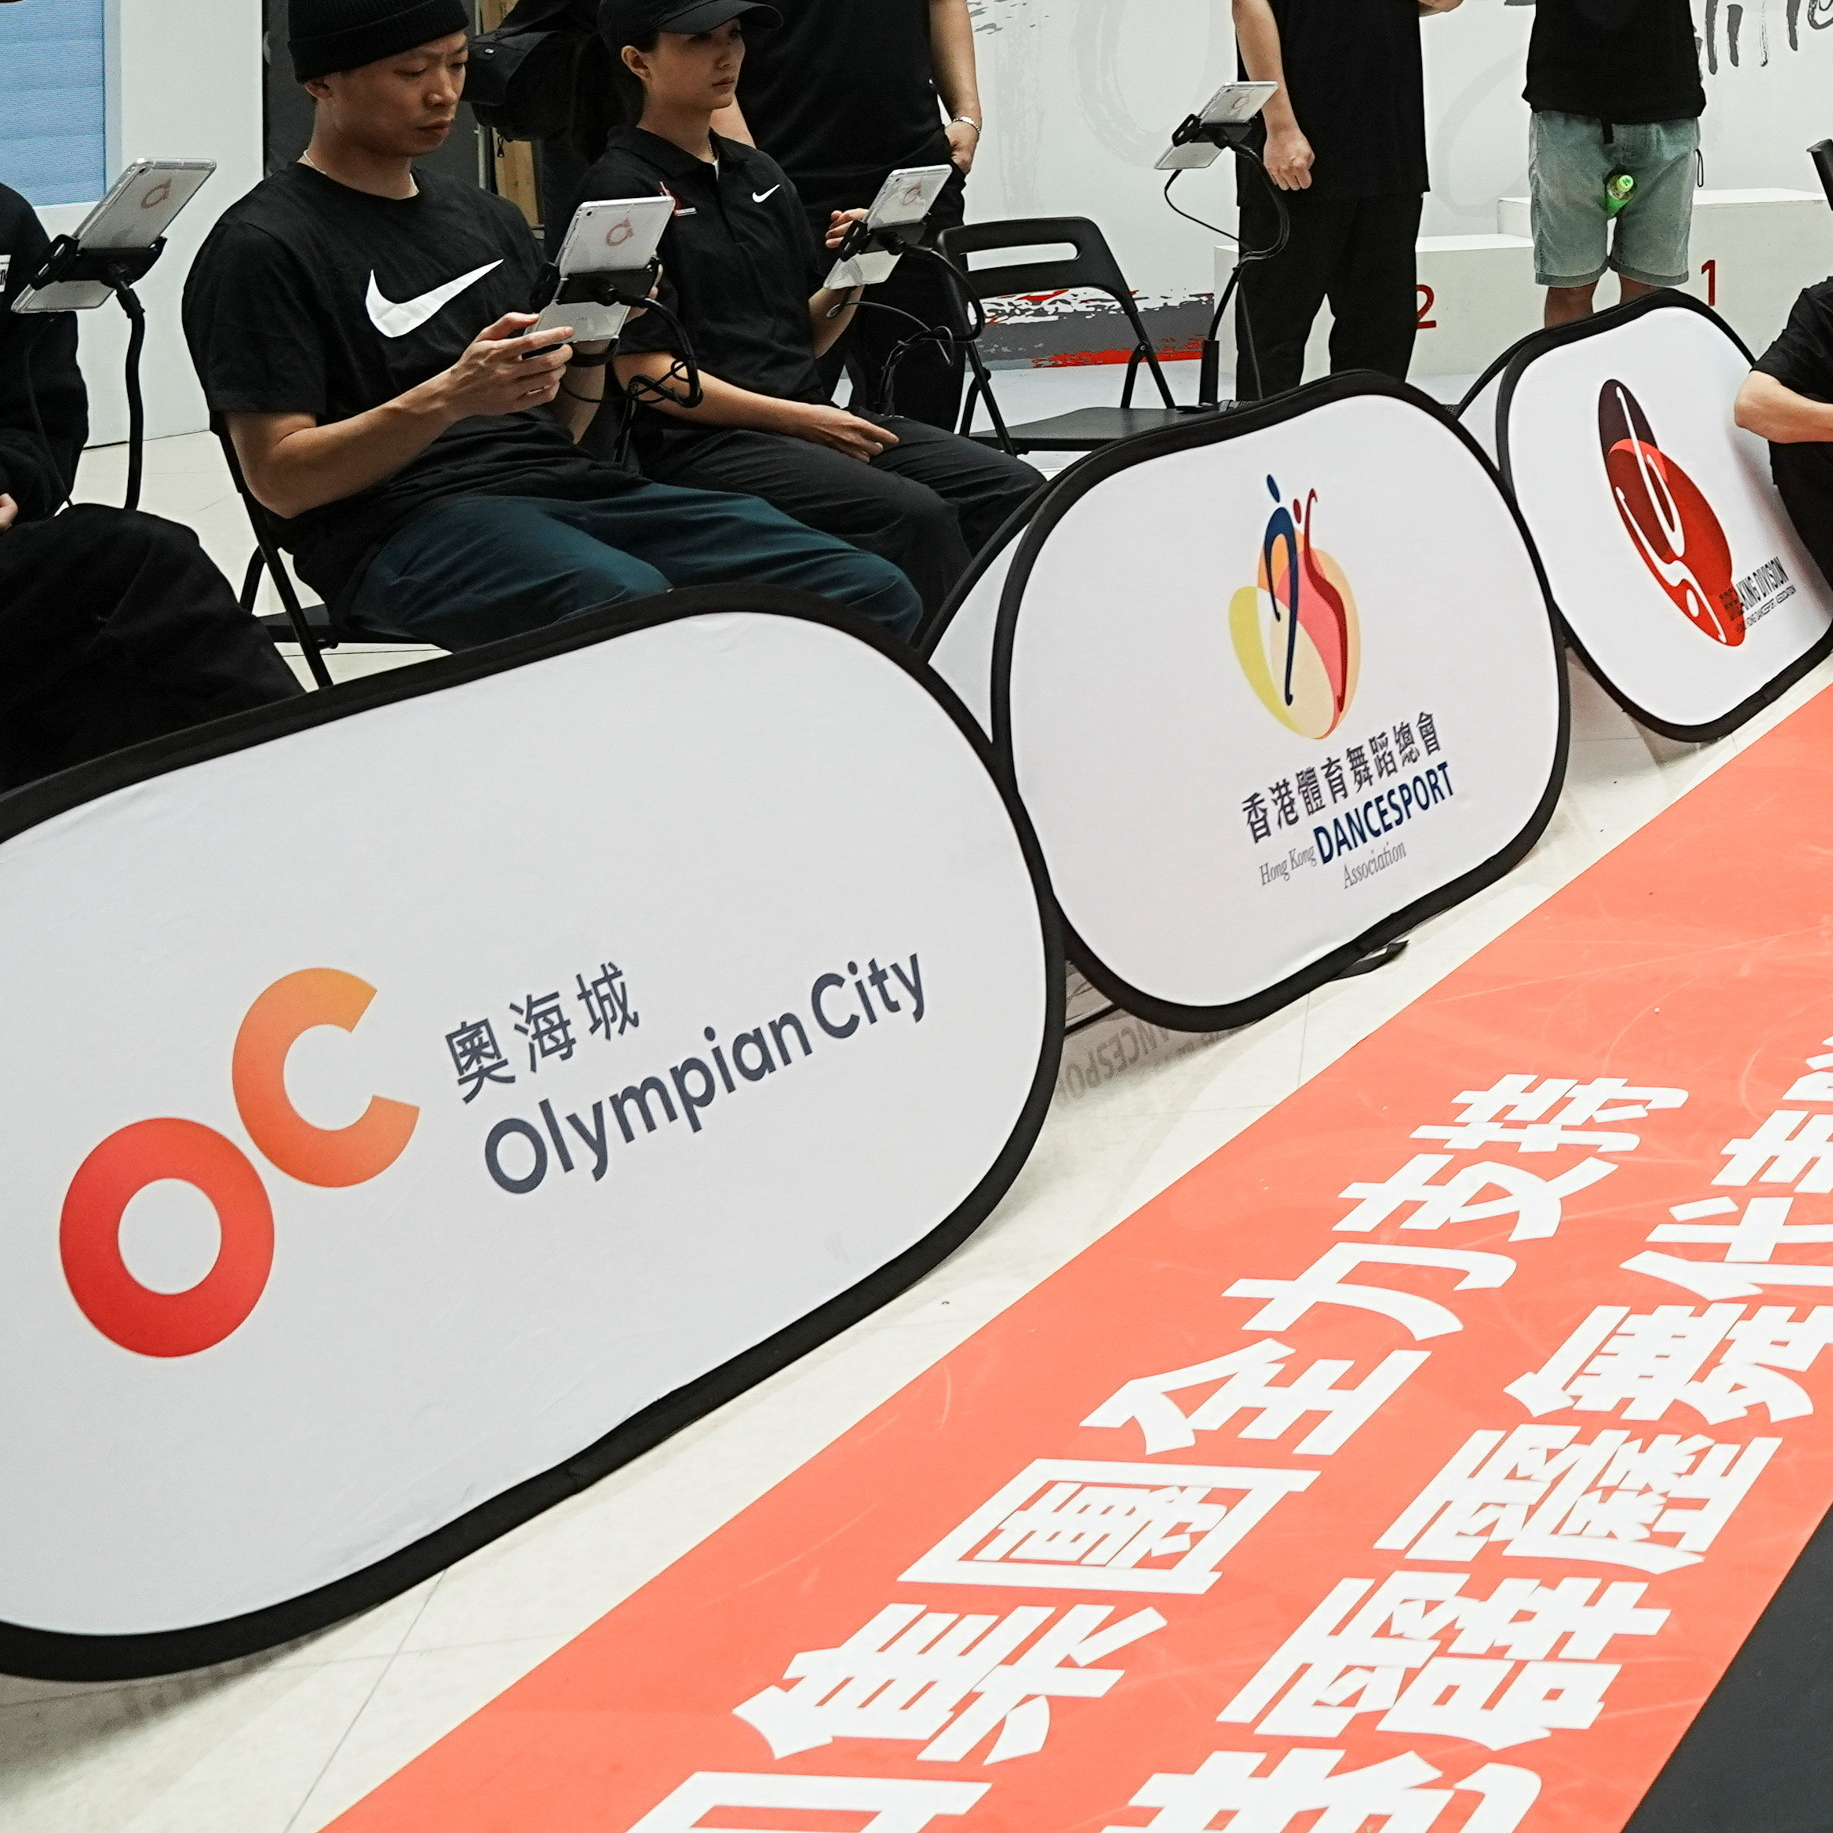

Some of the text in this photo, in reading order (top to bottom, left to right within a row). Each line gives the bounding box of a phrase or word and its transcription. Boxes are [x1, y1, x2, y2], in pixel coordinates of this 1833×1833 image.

[1701, 259, 1716, 306] 1
[1241, 711, 1443, 846] 香港體育舞蹈總會
[1259, 760, 1456, 886] Hong Kong DANCESPORT
[1343, 841, 1408, 889] Association
[444, 960, 641, 1104] 奧海城
[483, 952, 928, 1196] Olympian City
[59, 967, 420, 1358] OC
